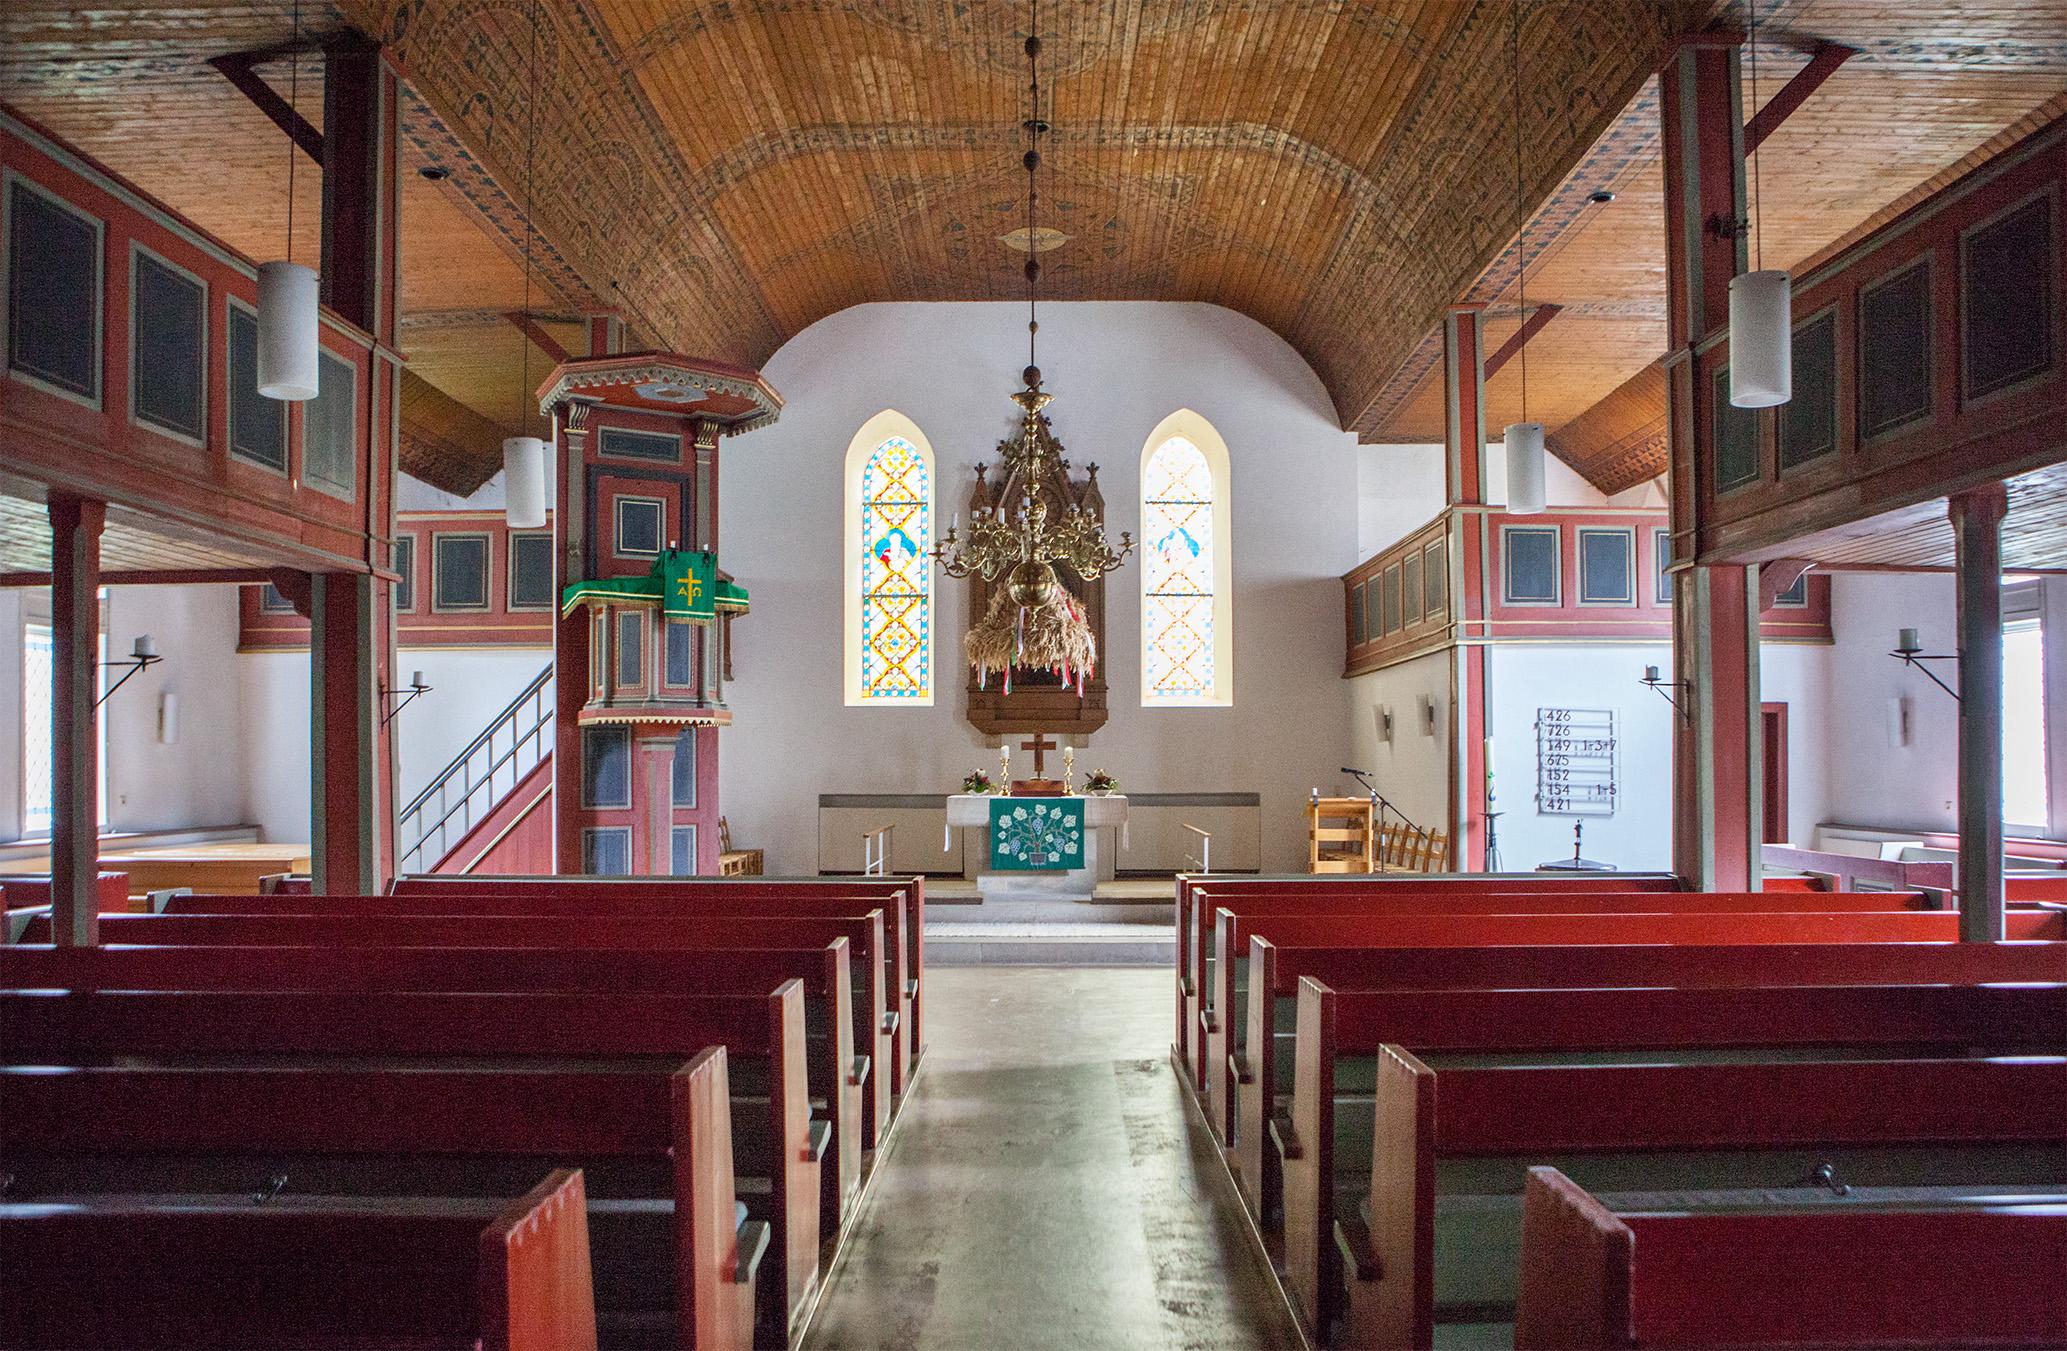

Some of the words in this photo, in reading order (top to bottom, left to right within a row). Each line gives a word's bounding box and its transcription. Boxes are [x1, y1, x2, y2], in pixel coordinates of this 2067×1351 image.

[1546, 710, 1571, 721] 426
[1547, 725, 1571, 736] 726
[1548, 740, 1571, 751] 149
[1546, 755, 1570, 766] 675
[1547, 770, 1570, 781] 152
[1547, 784, 1570, 796] 154
[1596, 784, 1617, 796] 1-5
[1546, 799, 1571, 811] 421
